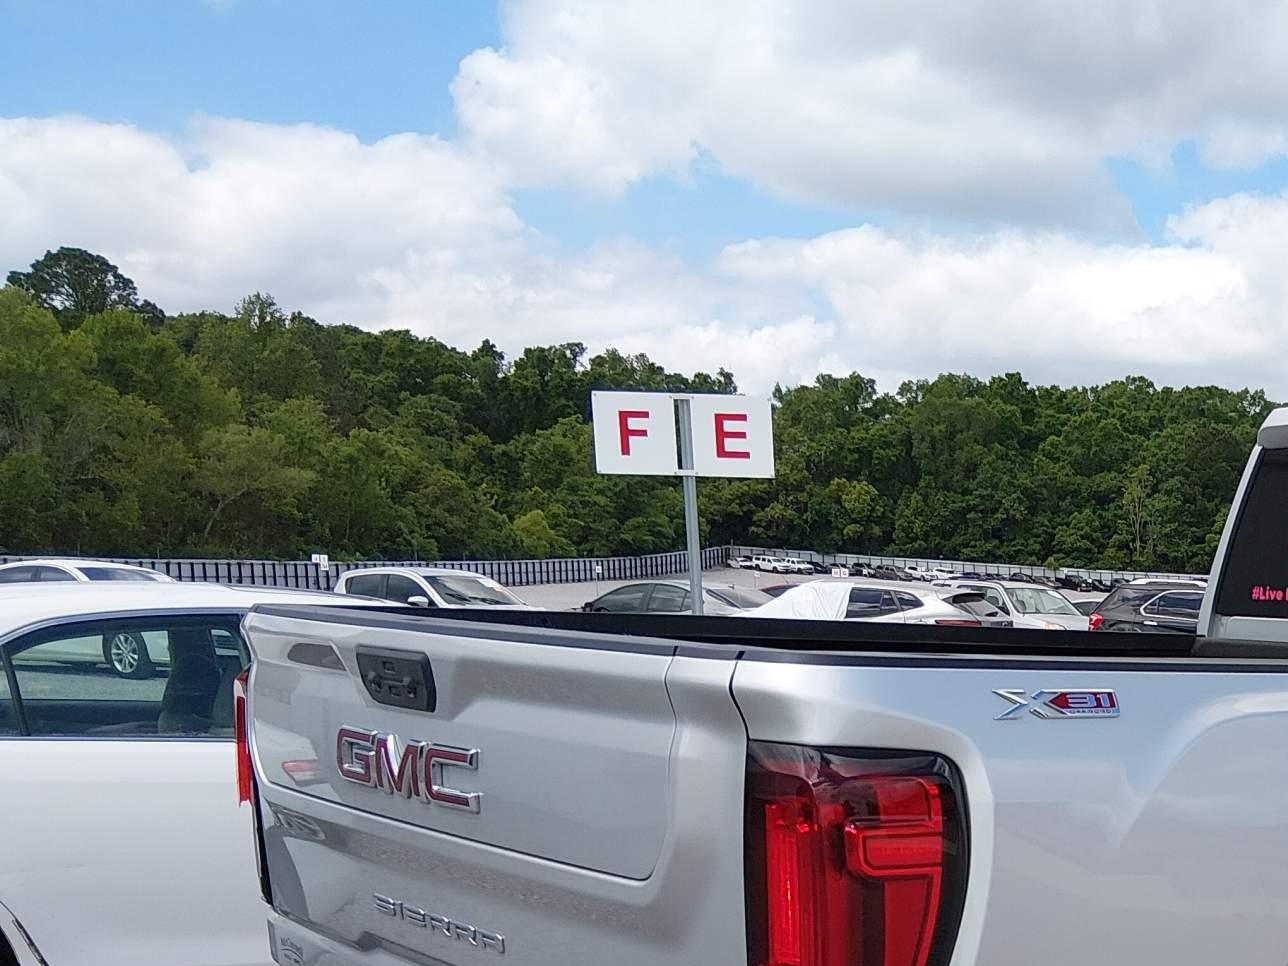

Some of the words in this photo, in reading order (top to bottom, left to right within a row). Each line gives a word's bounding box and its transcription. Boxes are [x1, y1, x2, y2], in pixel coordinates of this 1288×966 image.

[618, 410, 650, 456] F
[713, 412, 751, 460] E
[1252, 586, 1284, 601] #Live
[336, 725, 482, 814] GMC
[373, 892, 506, 954] SIERRA
